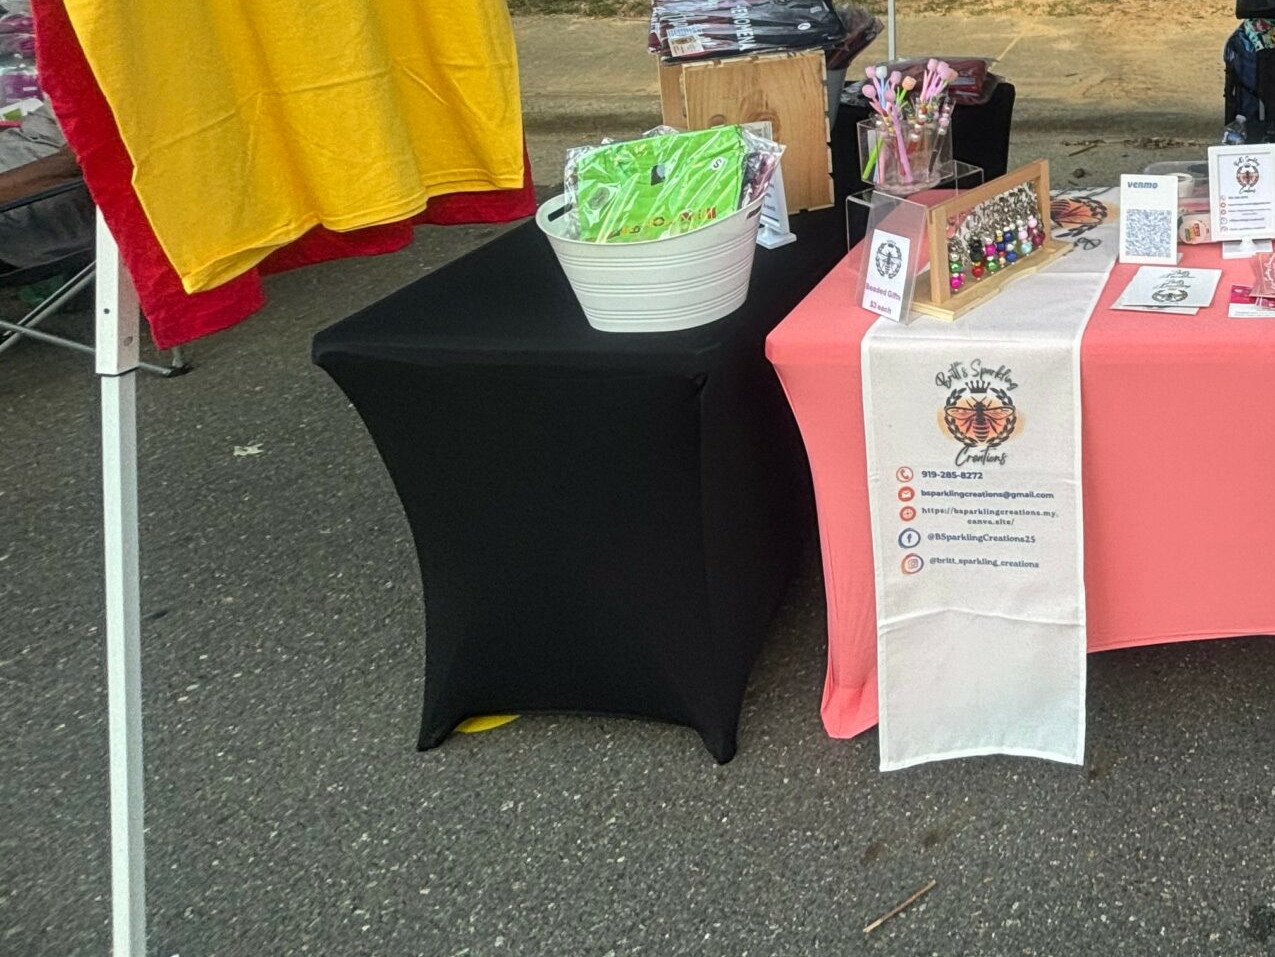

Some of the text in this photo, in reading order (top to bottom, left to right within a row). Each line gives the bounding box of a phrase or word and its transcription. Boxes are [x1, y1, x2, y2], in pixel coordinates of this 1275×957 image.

[1127, 181, 1158, 189] venmo
[935, 358, 1019, 390] Britt's Sparkling
[955, 446, 1007, 467] Creations
[921, 470, 984, 479] 919-285-8272
[920, 490, 1055, 499] bsparklingcreations@gmail.com
[967, 518, 1015, 526] canva.site/
[927, 532, 1036, 543] @BSparklingCreations25
[929, 557, 1040, 568] @britt_sparkling_creations
